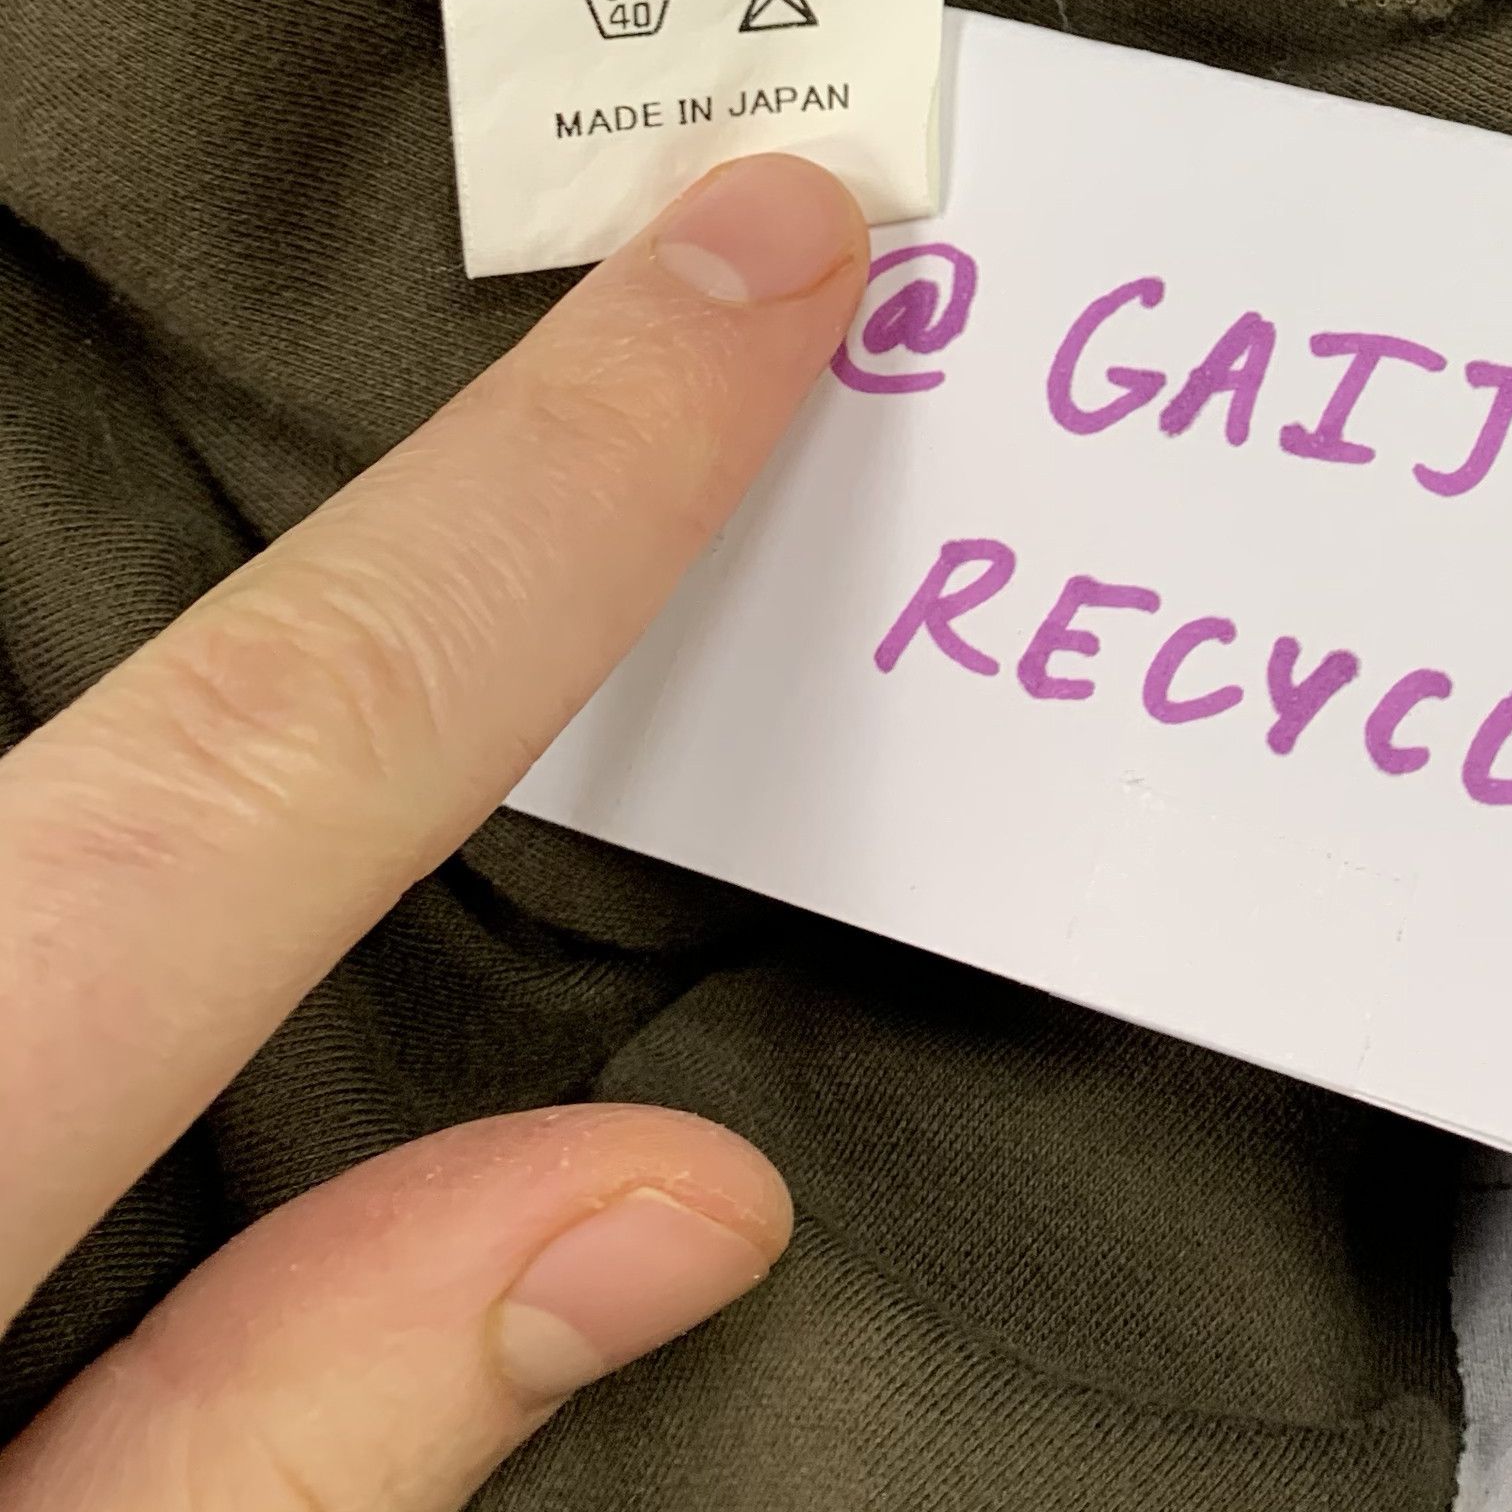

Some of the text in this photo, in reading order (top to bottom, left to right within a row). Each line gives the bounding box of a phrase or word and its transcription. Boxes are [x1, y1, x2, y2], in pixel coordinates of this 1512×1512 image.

[609, 2, 651, 28] 40
[556, 84, 850, 139] MADE IN JAPAN
[832, 242, 978, 394] @
